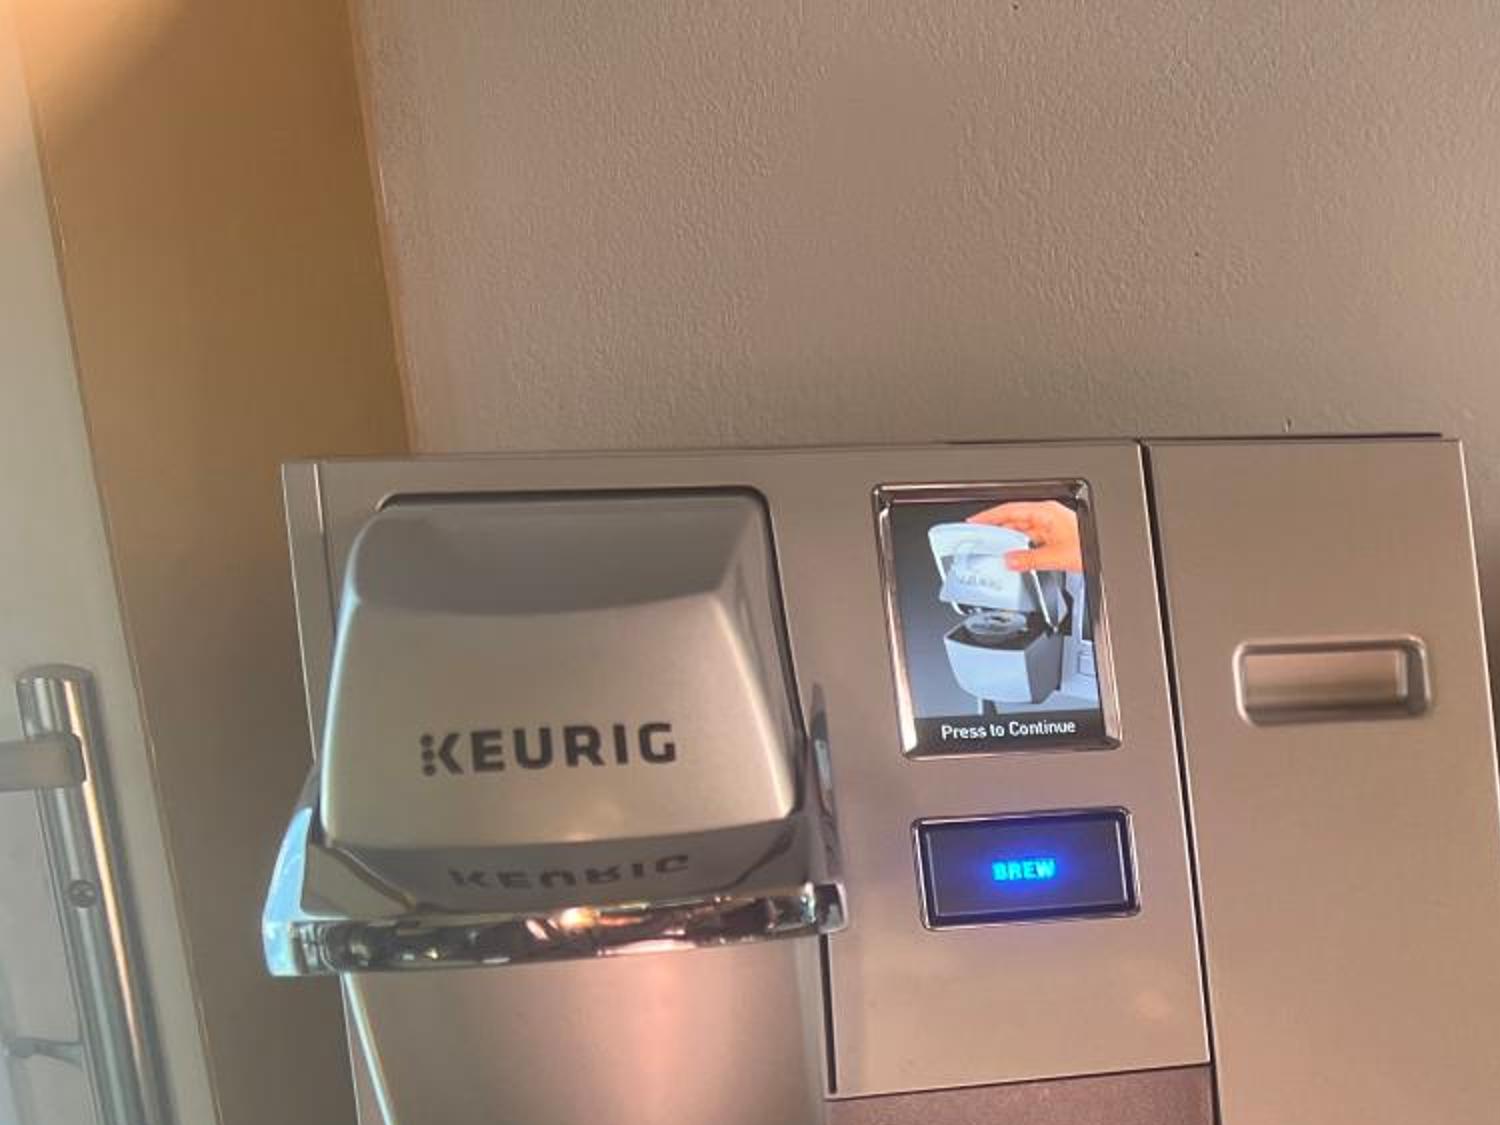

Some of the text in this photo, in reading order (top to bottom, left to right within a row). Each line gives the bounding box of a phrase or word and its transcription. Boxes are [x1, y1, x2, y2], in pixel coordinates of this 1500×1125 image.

[941, 718, 1077, 741] Press to Continue
[420, 722, 678, 777] KEURIG
[992, 857, 1057, 881] BREW
